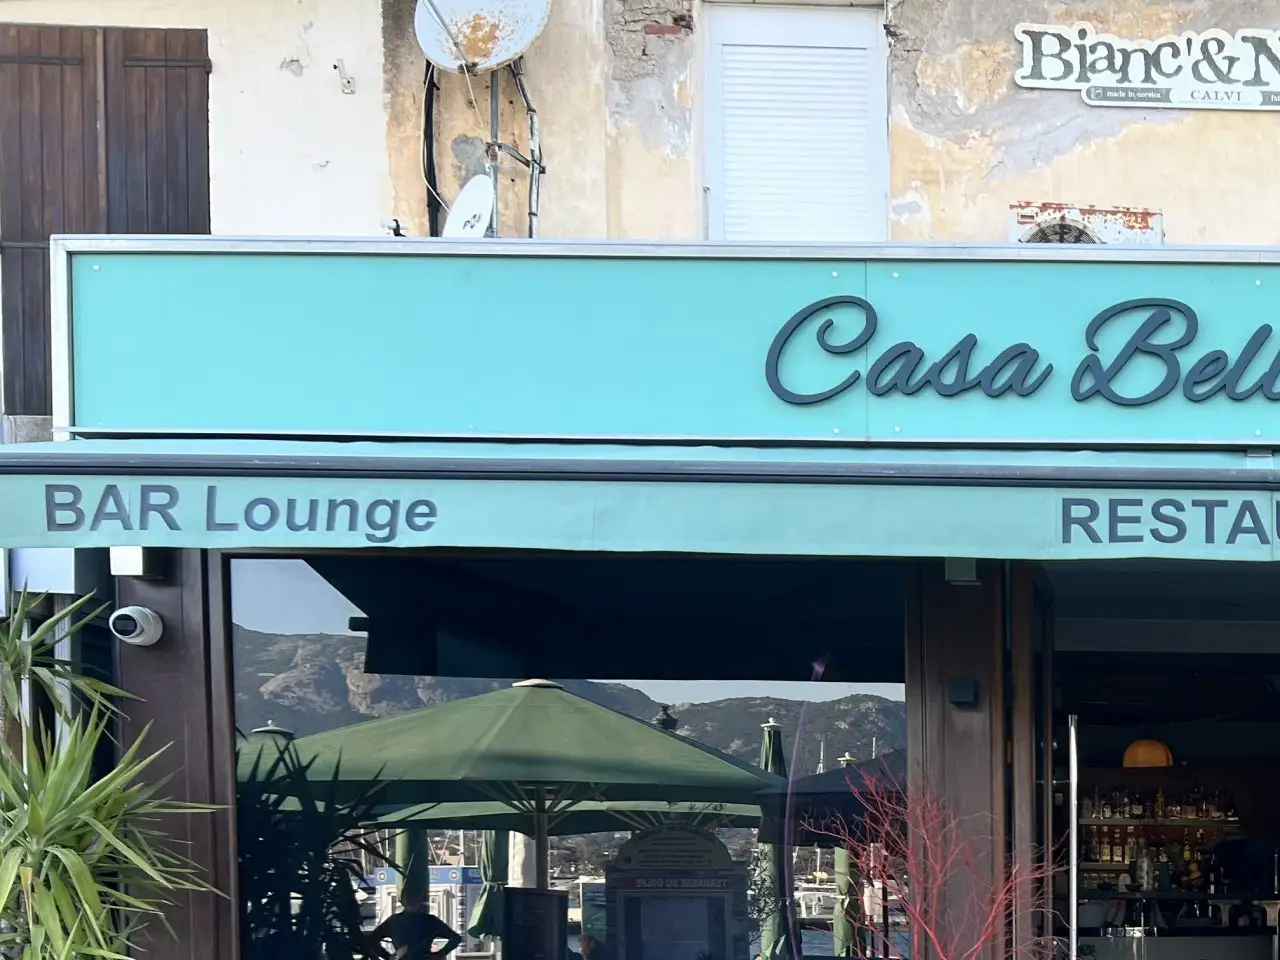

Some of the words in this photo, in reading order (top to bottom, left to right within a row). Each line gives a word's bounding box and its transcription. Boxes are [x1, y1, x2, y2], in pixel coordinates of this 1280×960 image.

[1020, 27, 1192, 84] Bianc'
[1190, 90, 1242, 101] CALVI
[765, 297, 1053, 404] Casa
[45, 484, 182, 532] BAR
[206, 485, 438, 543] Lounge
